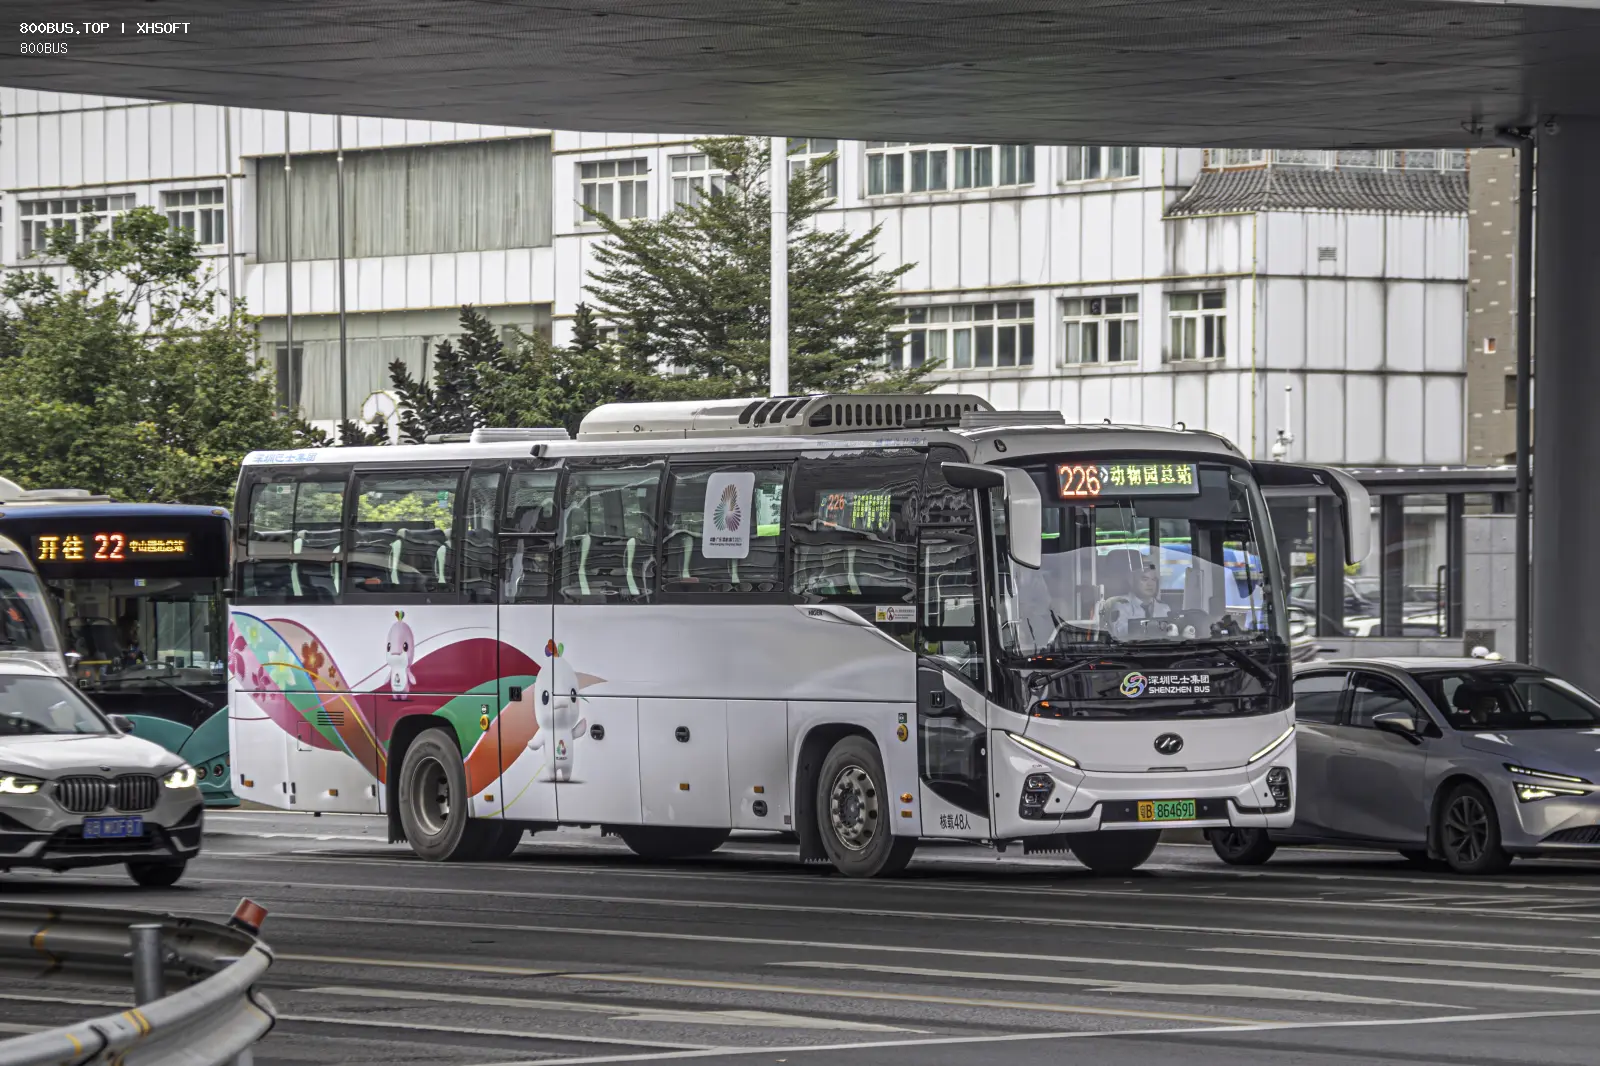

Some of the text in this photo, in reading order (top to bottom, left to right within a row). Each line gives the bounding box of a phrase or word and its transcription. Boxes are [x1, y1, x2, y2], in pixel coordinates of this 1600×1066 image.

[1059, 464, 1193, 496] 226 动物园总站
[38, 535, 84, 560] 开往
[93, 533, 126, 560] 22
[1148, 674, 1210, 685] 深圳巴士集团
[1148, 685, 1211, 694] SHENZHEN BUS
[940, 813, 971, 830] 核载48人
